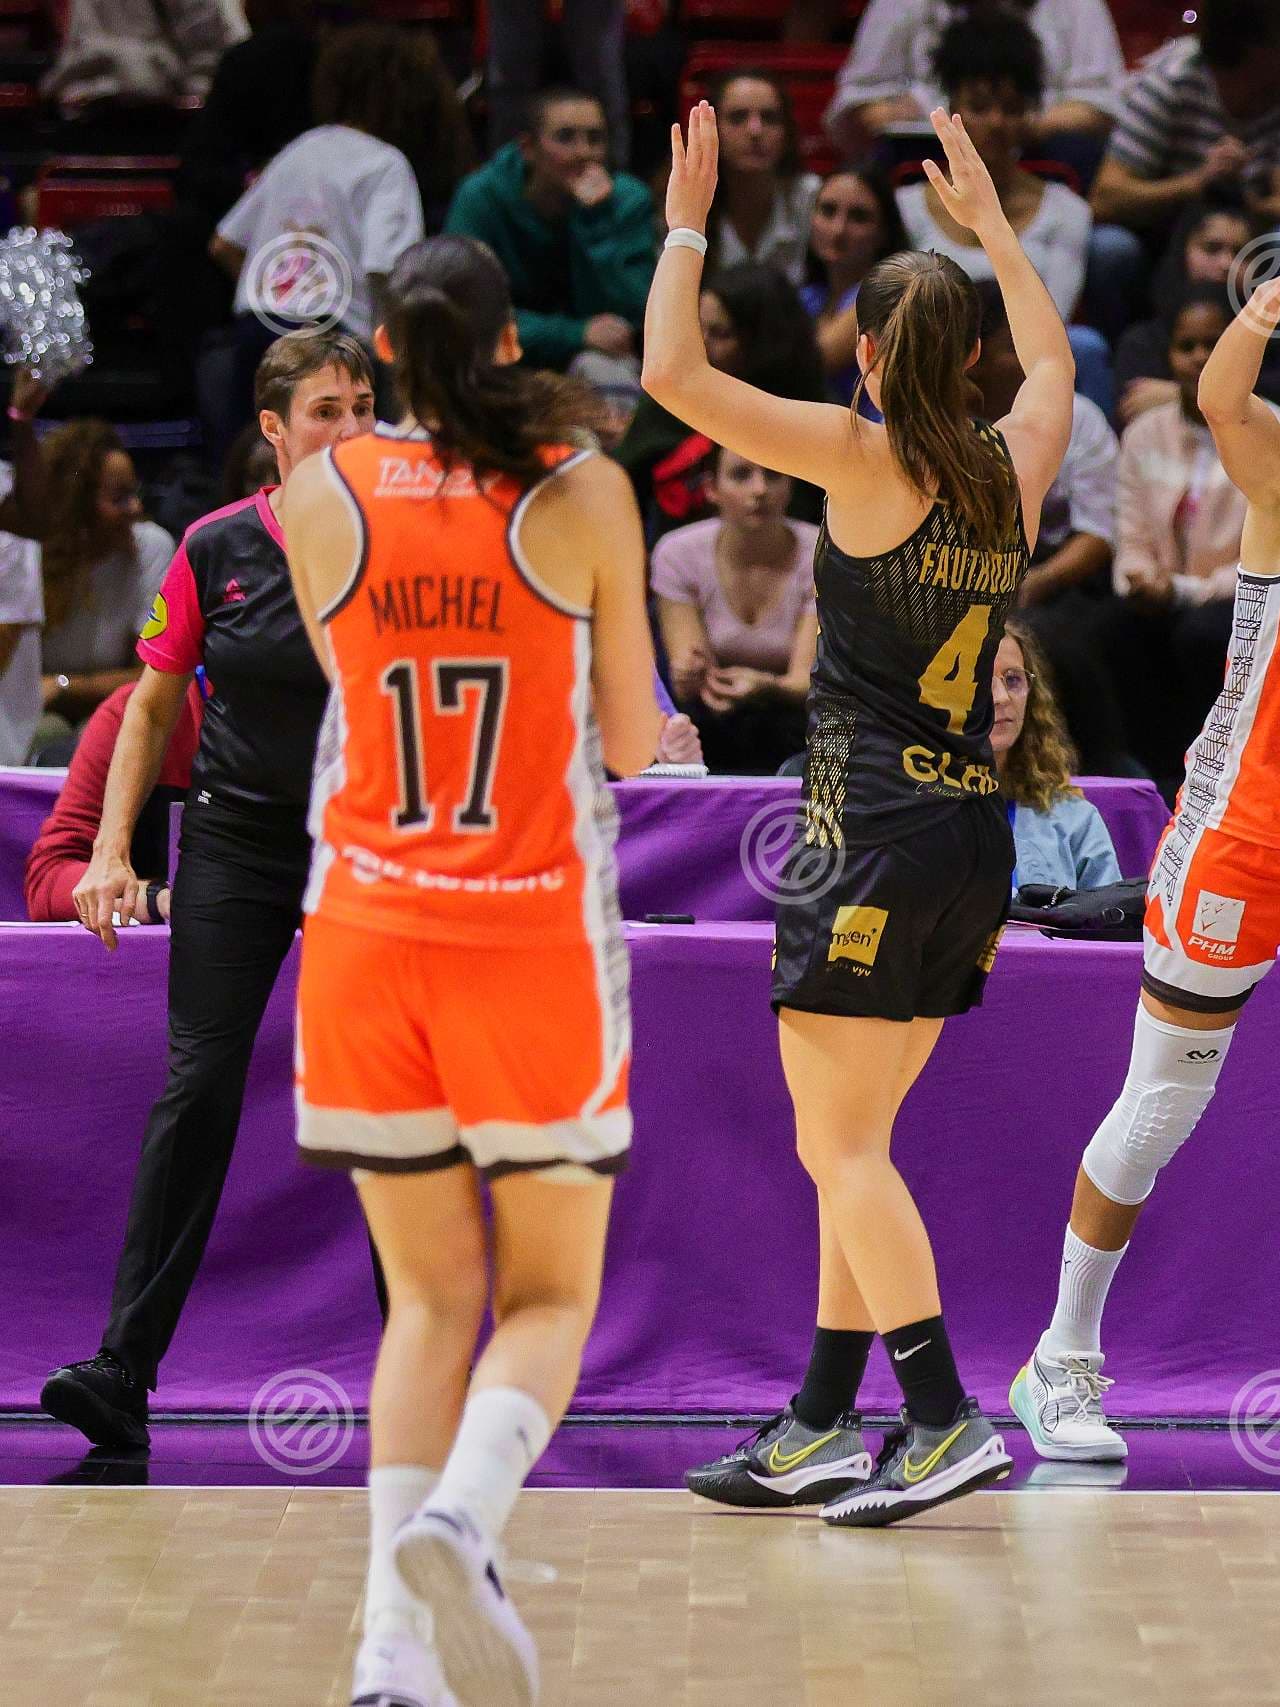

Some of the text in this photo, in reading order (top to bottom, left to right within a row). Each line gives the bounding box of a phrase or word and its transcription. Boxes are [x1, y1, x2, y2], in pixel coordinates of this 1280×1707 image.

[367, 575, 506, 638] MICHEL
[917, 603, 993, 736] 4
[380, 656, 510, 837] 17
[1188, 935, 1238, 956] PHM
[1207, 952, 1235, 962] GROUP
